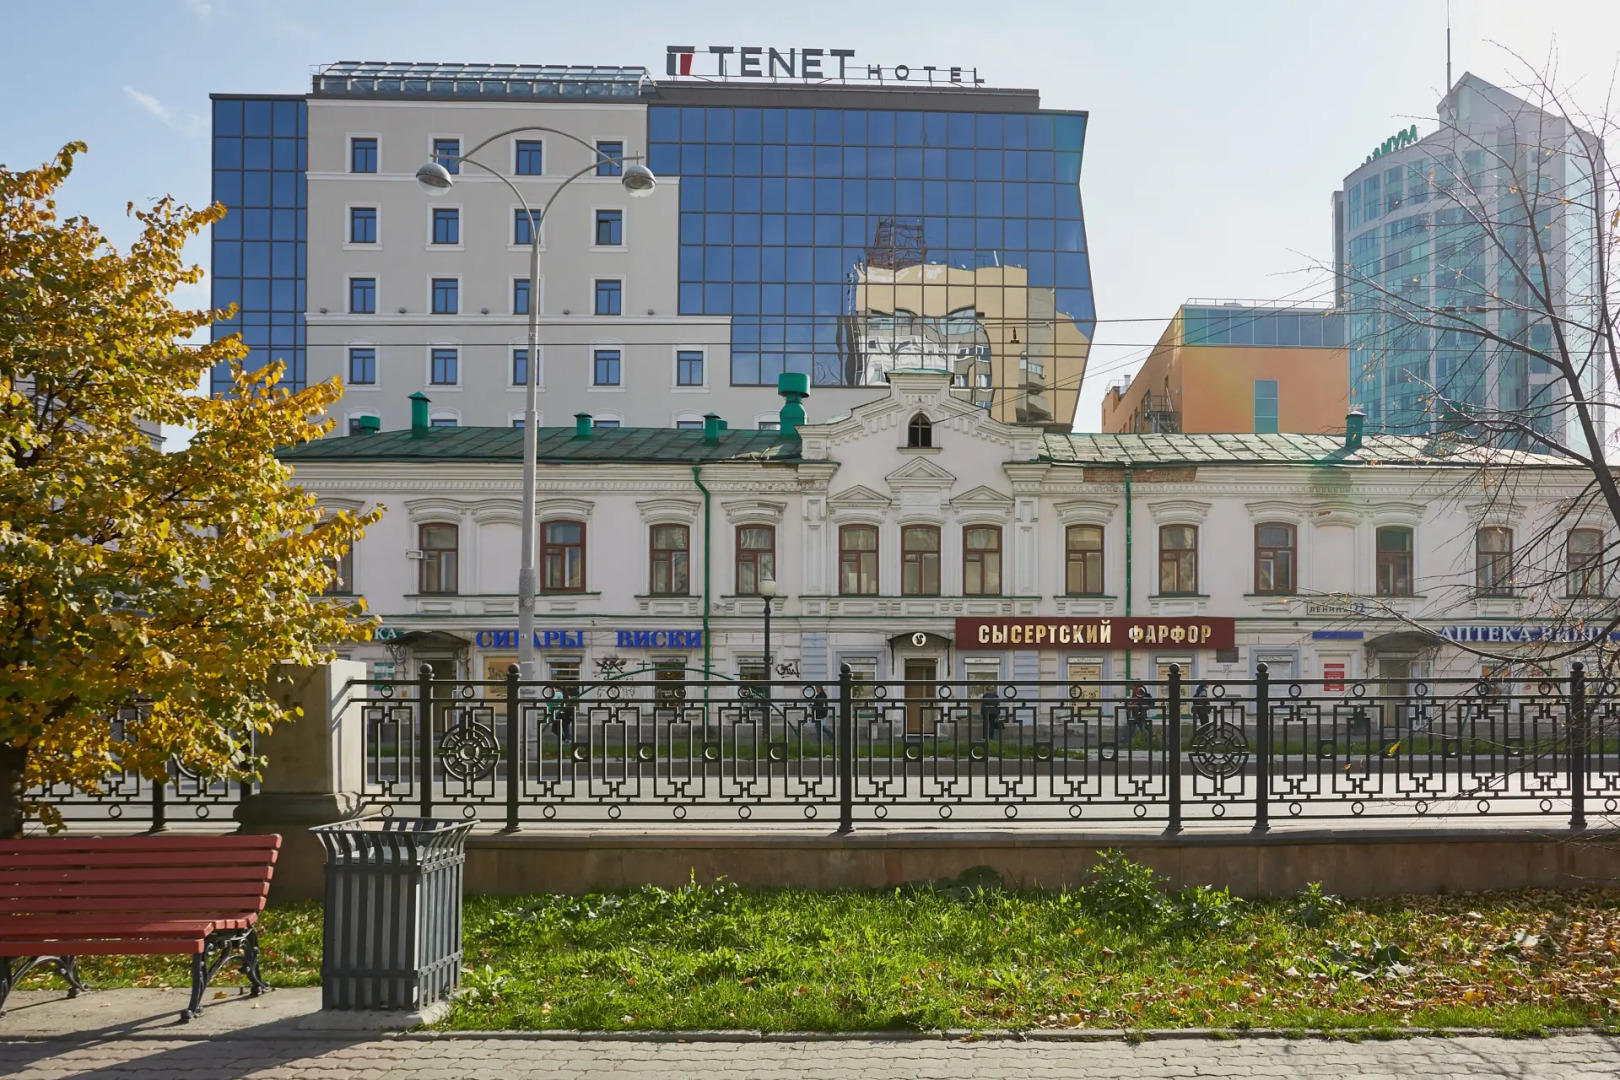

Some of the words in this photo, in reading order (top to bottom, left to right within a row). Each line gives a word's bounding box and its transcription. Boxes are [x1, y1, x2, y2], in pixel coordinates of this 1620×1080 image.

[708, 45, 855, 79] TENET
[868, 64, 985, 84] HOTEL
[615, 630, 703, 648] ВИСКИ
[978, 619, 1111, 644] СЫСЕРТСКИЙ
[1128, 624, 1212, 644] ФАРФОР
[1440, 626, 1533, 642] АПТЕКА
